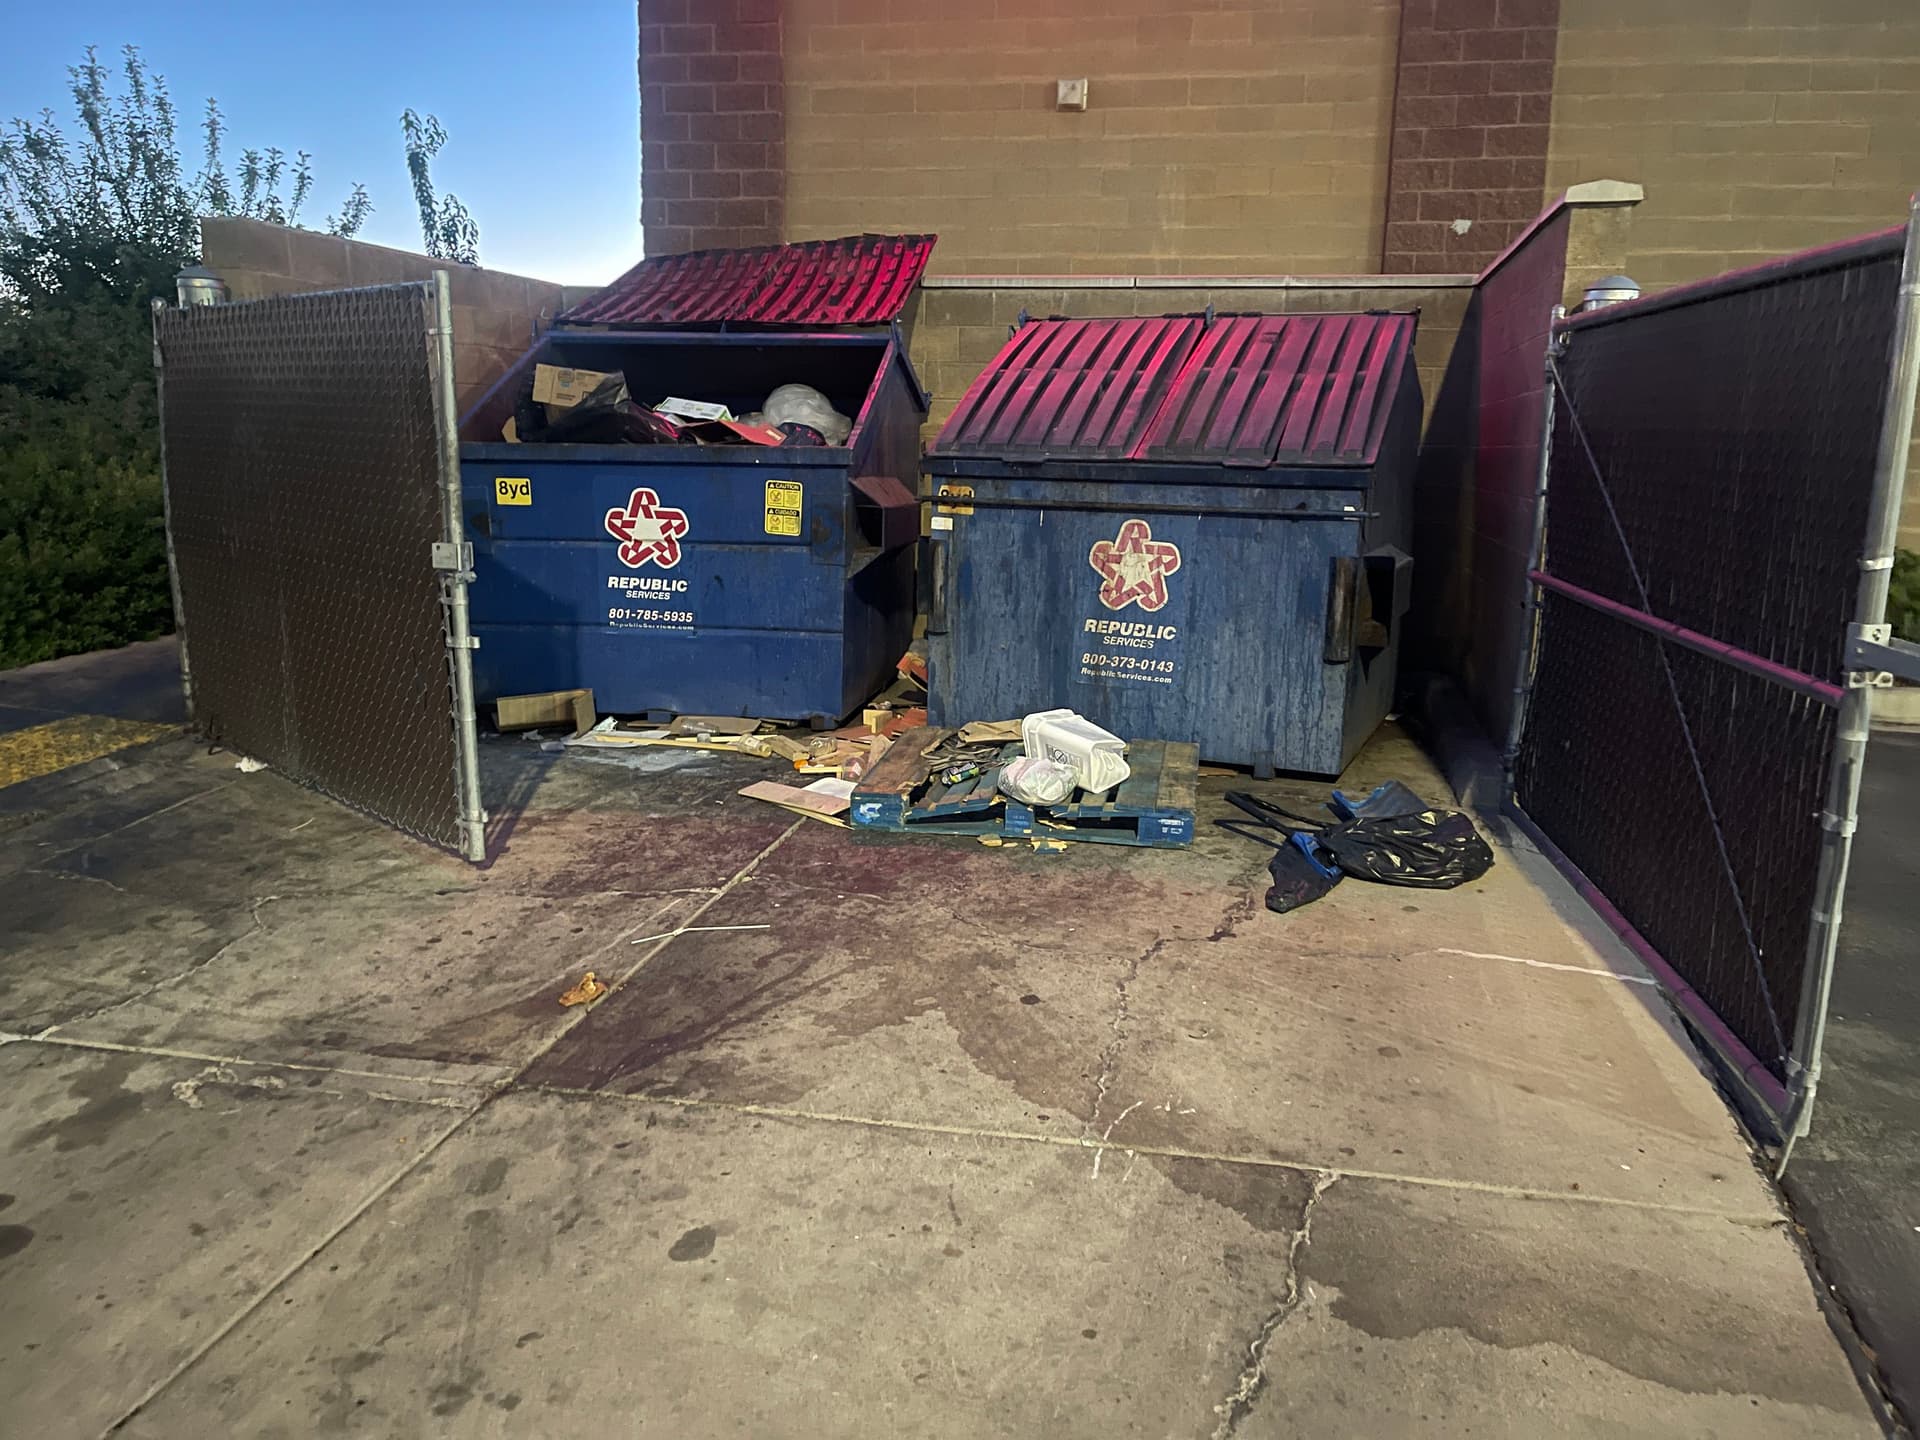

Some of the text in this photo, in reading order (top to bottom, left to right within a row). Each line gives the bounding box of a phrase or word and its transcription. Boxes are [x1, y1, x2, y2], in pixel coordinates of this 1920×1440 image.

[498, 480, 530, 500] 8yd
[775, 482, 800, 490] CAUTION
[607, 575, 689, 593] REPUBLIC
[625, 590, 671, 601] SERVICES
[608, 608, 693, 623] 801-785-5935
[1083, 618, 1177, 641] REPUBLIC
[1103, 635, 1155, 649] SERVICES
[1081, 652, 1174, 673] 800-373-0143
